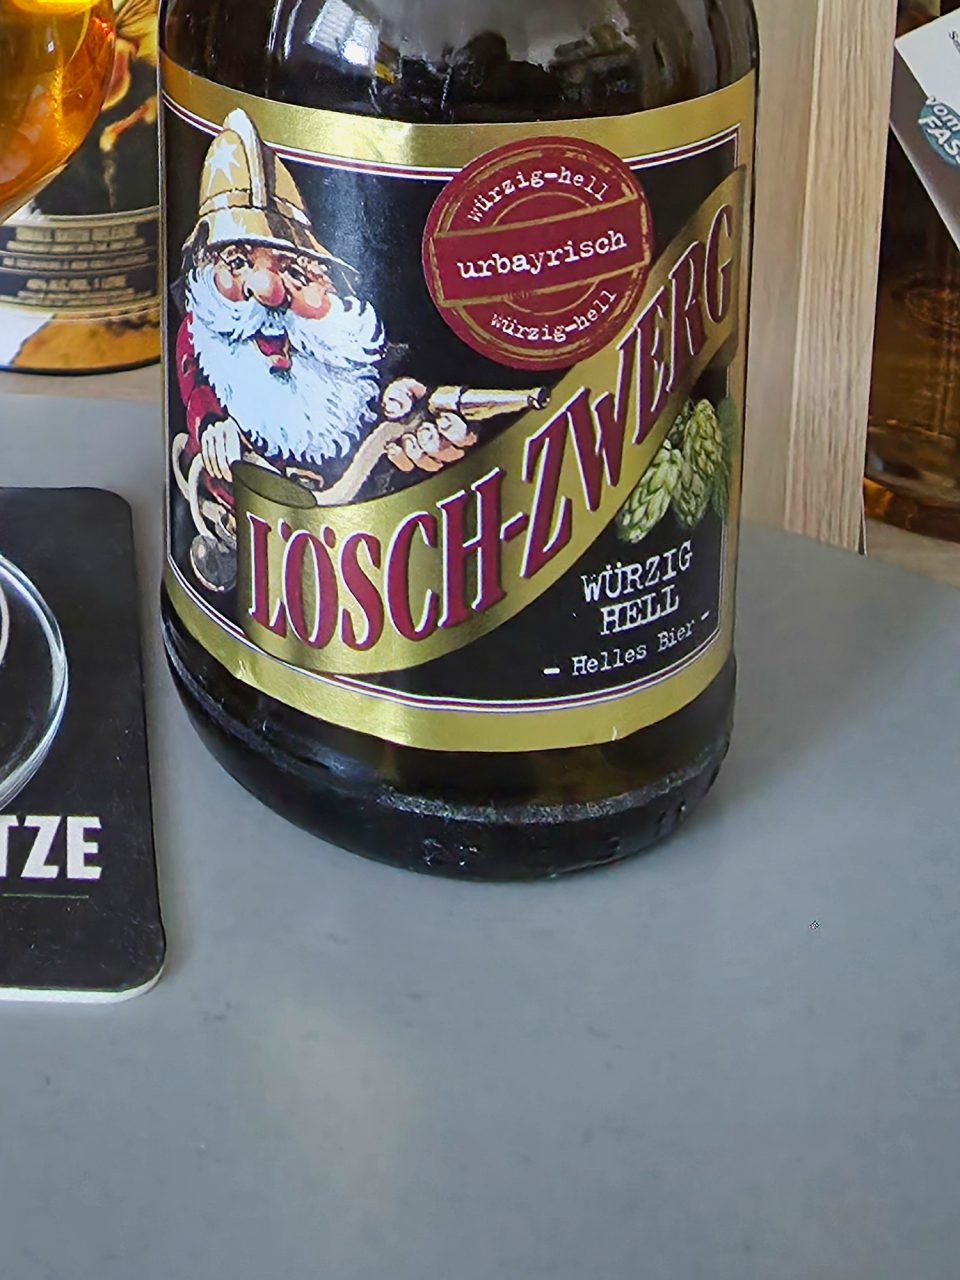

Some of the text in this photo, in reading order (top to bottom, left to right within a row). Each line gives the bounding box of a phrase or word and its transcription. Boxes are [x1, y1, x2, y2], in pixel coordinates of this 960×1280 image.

[467, 165, 609, 224] würzig-hell
[457, 228, 628, 280] urbayrisch
[490, 288, 619, 343] würzig-hell
[580, 540, 693, 603] WÜRZIG
[600, 584, 680, 636] HELL
[571, 619, 696, 677] Helles Bier
